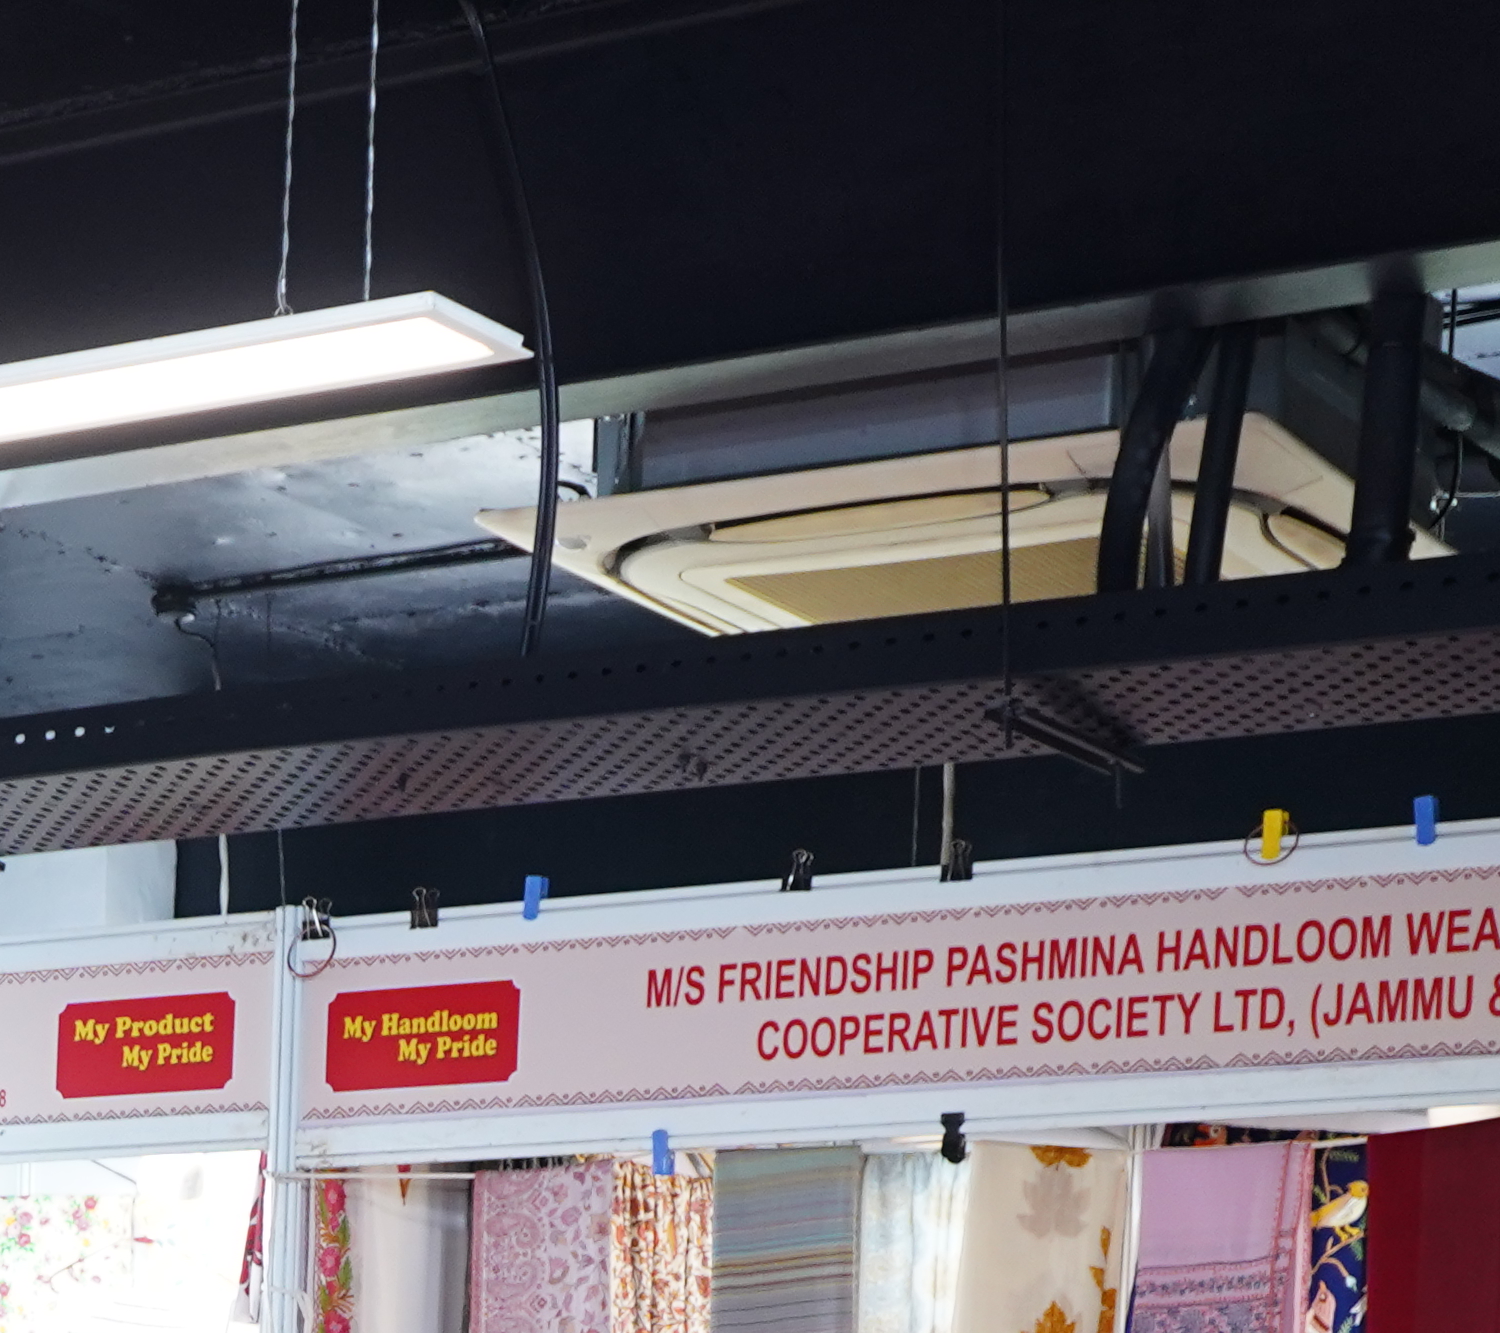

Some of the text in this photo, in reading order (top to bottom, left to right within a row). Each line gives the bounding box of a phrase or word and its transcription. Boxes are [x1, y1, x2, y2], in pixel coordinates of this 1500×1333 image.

[646, 966, 705, 1009] M/S
[717, 947, 935, 1004] FRIENDSHIP
[946, 932, 1145, 988] PASHMINA
[1156, 914, 1393, 973] HANDLOOM
[73, 1011, 214, 1044] My Product
[342, 1009, 498, 1041] My Handloom
[757, 1004, 1018, 1061] COOPERATIVE
[1031, 991, 1203, 1045] SOCIETY
[1212, 986, 1296, 1037] LTD,
[1310, 974, 1475, 1038] (JAMMU
[121, 1041, 214, 1071] My Pride
[398, 1034, 498, 1065] My Pride
